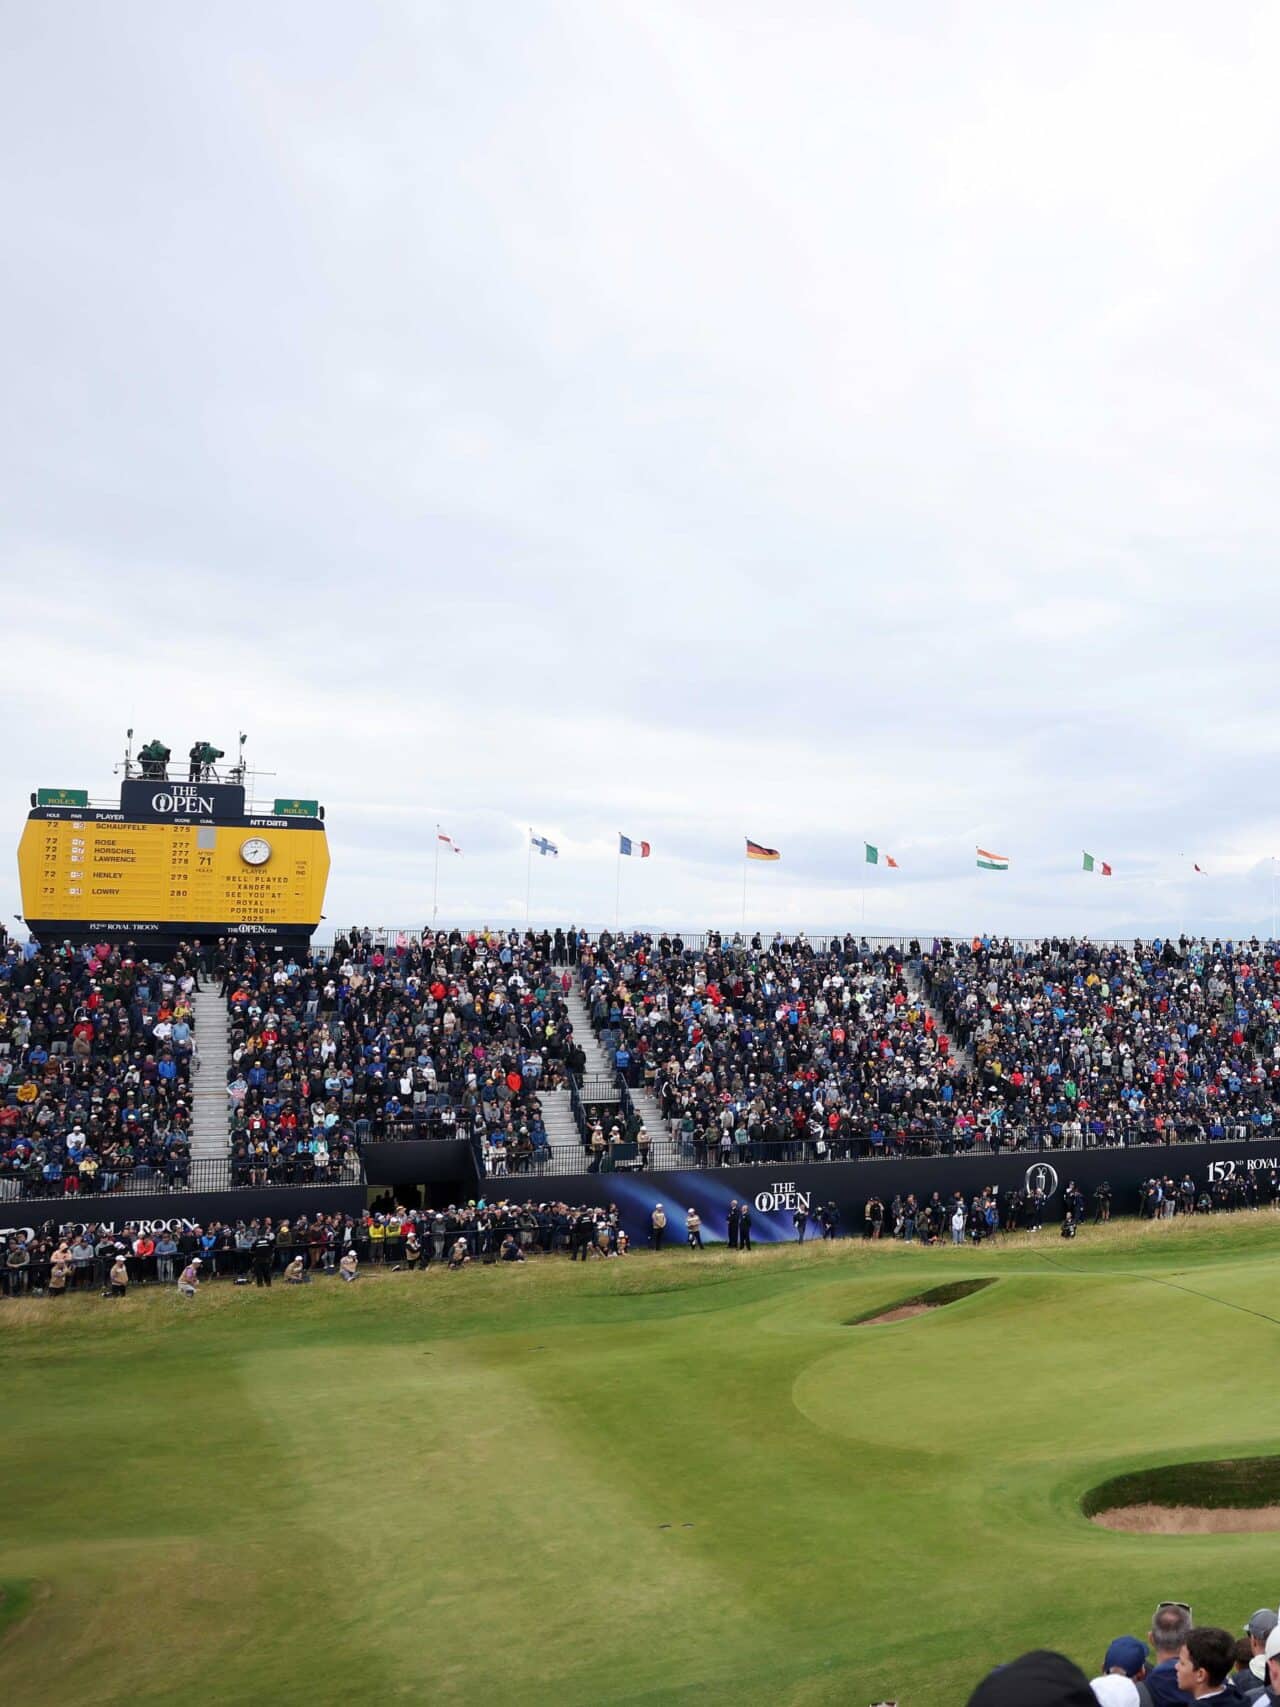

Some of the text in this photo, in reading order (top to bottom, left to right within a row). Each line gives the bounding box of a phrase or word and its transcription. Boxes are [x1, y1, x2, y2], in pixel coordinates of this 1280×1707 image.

[171, 785, 197, 797] THE
[152, 793, 215, 814] OPEN
[95, 822, 148, 831] SCHAUFFELE
[173, 825, 191, 833] 275
[94, 847, 137, 855] HORSCHEL
[93, 855, 137, 863] LAWRENCE
[199, 856, 212, 866] 71
[43, 870, 56, 878] 72
[92, 871, 123, 879] HENLEY
[1247, 1158, 1280, 1170] ROYAL
[771, 1182, 796, 1193] THE
[755, 1192, 812, 1212] OPEN
[125, 1218, 199, 1234] TROON
